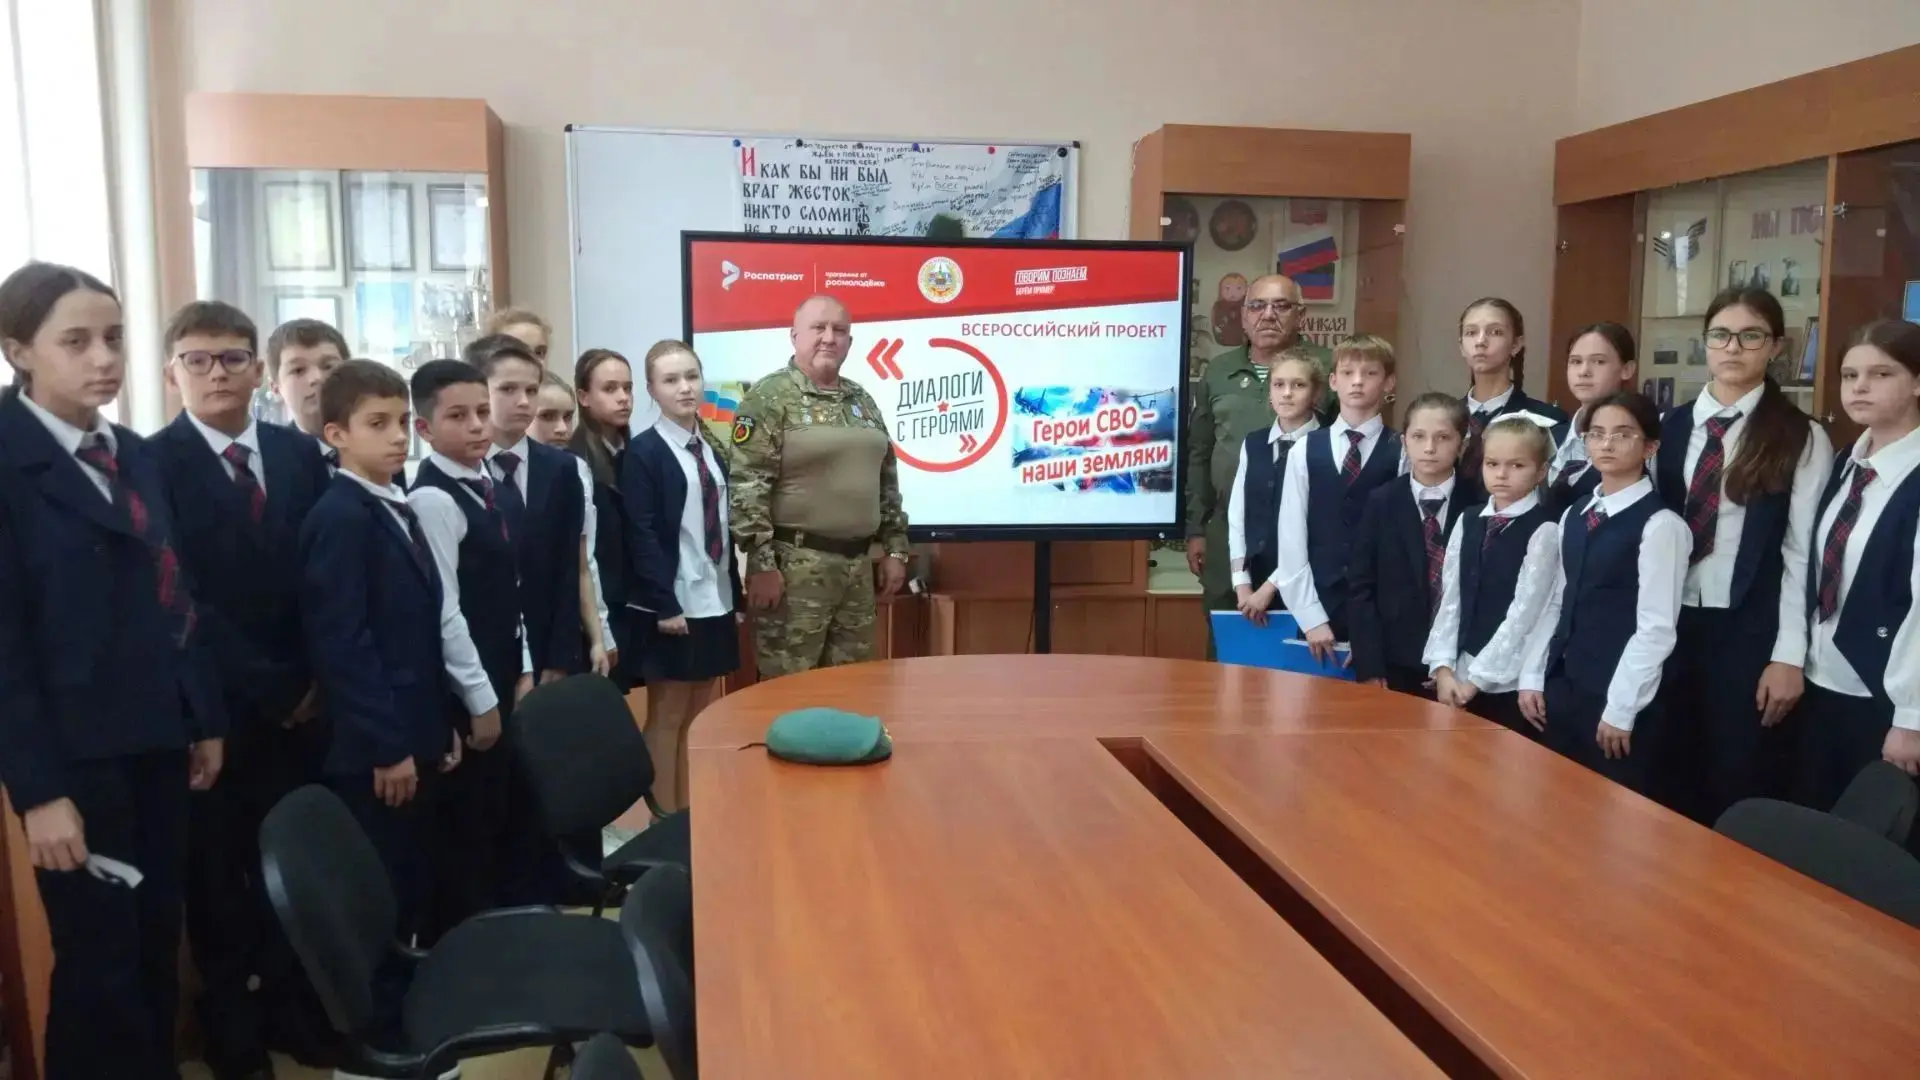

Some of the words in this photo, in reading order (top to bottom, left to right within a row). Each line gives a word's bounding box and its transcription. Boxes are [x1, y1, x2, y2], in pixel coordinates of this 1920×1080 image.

[741, 147, 756, 177] И
[760, 163, 791, 179] КАК
[800, 164, 821, 180] БЫ
[830, 165, 848, 181] НИ
[857, 166, 889, 183] БЫЛ
[743, 183, 779, 198] ВРАГ
[743, 203, 791, 219] НИКТО
[800, 205, 870, 222] СЛОМИТЬ
[743, 271, 804, 282] Роспатриот
[961, 321, 1100, 338] ВСЕРОССИЙСКИЙ
[1106, 324, 1167, 338] ПРОЕКТ
[896, 370, 983, 411] ДИАЛОГИ
[897, 421, 905, 442] С
[912, 408, 984, 440] ГЕРОЯМИ
[1033, 418, 1090, 445] Герои
[1096, 406, 1137, 433] СВО
[1022, 459, 1077, 484] наши
[1082, 445, 1168, 474] земляки
